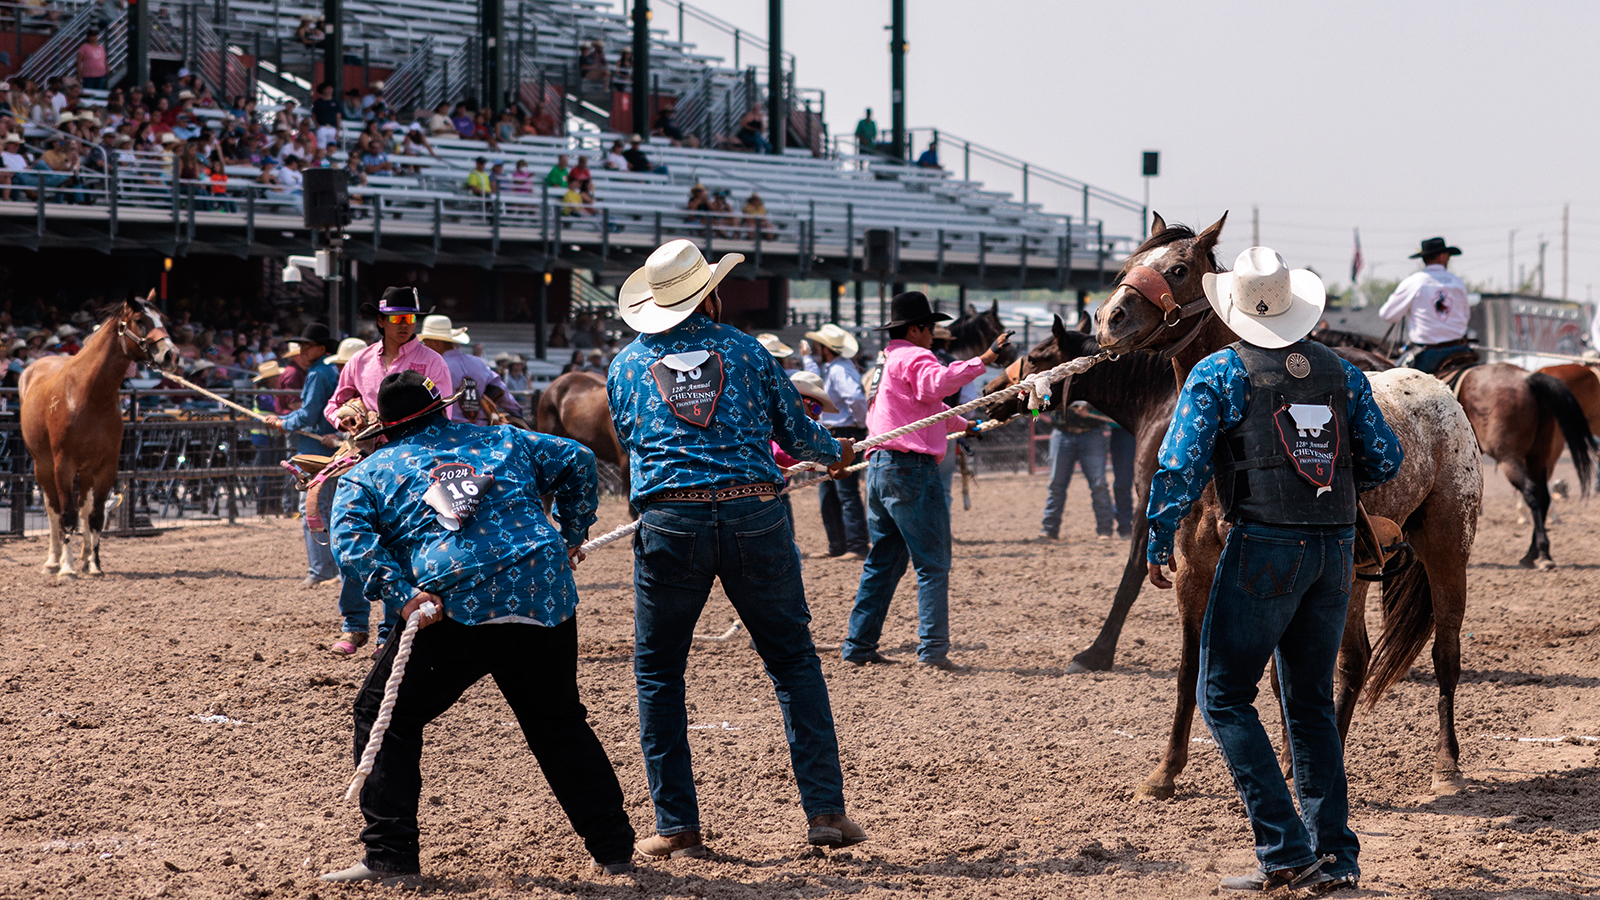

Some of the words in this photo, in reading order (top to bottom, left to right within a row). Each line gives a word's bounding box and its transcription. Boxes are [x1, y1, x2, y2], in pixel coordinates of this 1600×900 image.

[687, 380, 712, 391] Annual
[466, 389, 476, 400] 14
[670, 390, 716, 402] CHEYENNE
[1309, 440, 1330, 448] Annual
[1292, 448, 1334, 460] CHEYENNE
[440, 468, 468, 482] 2024
[446, 480, 479, 500] 16
